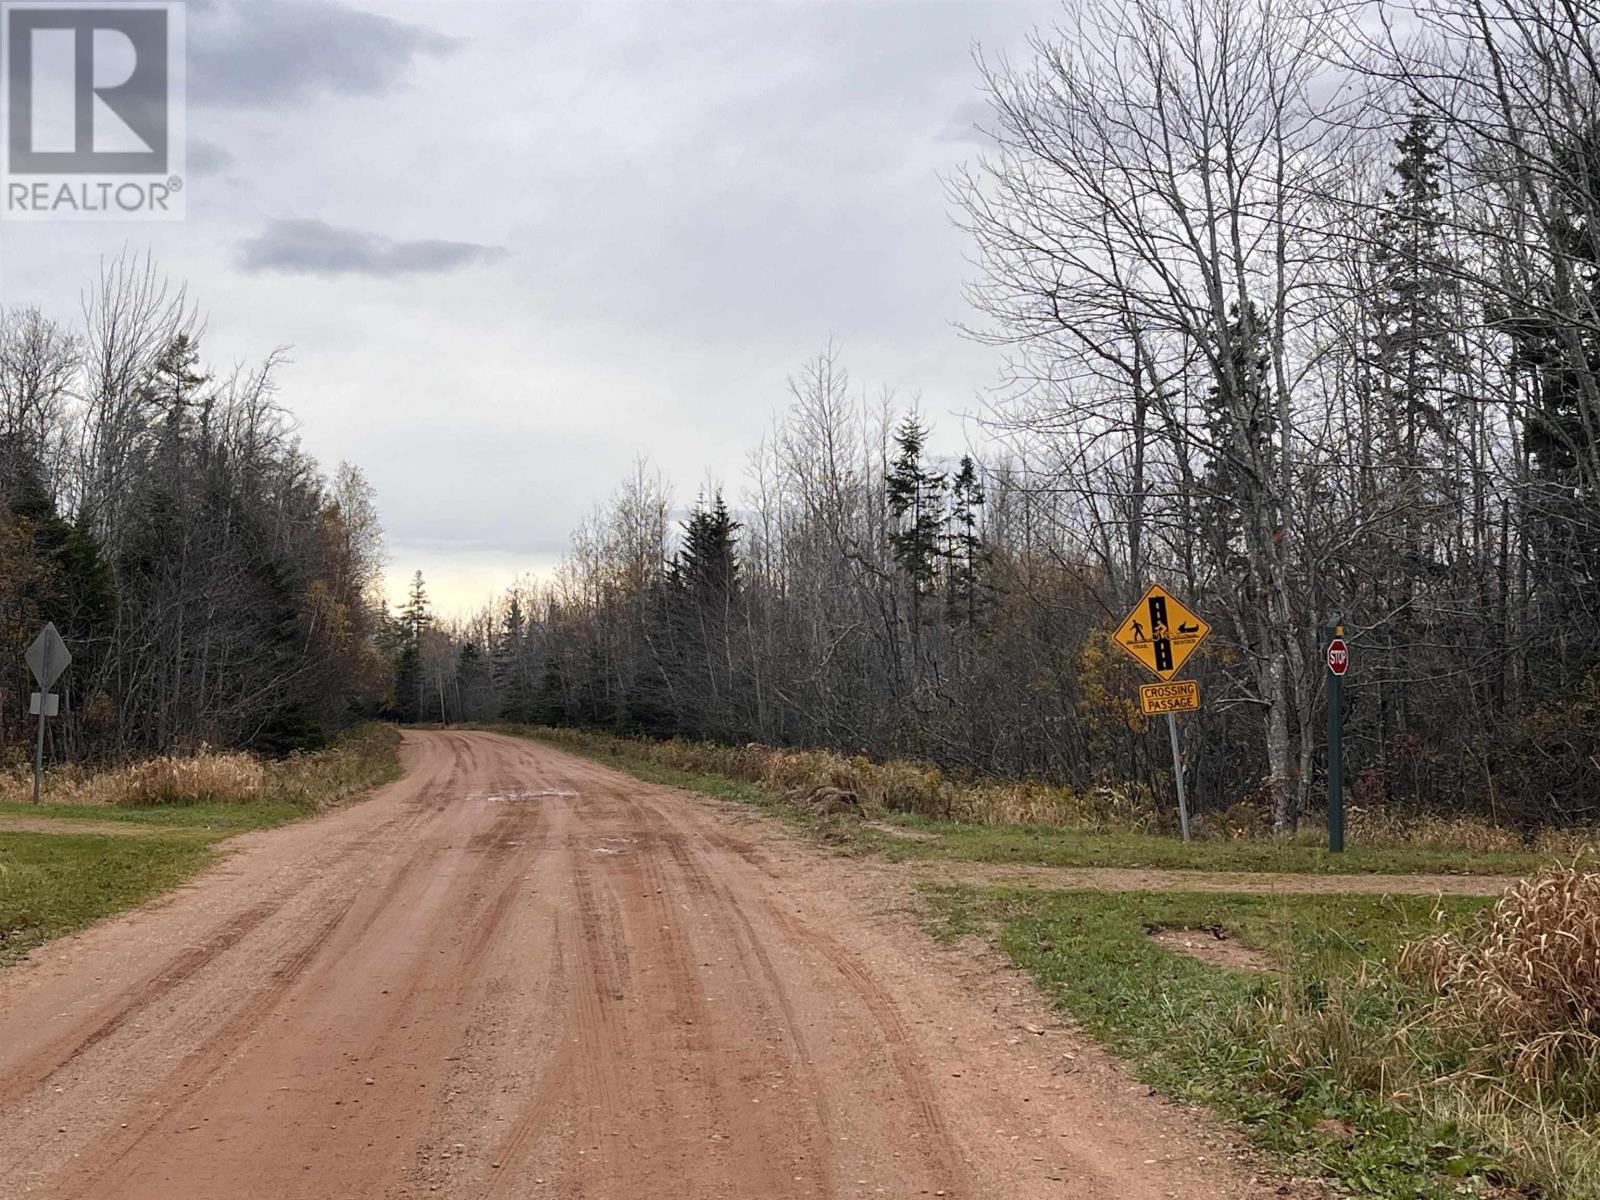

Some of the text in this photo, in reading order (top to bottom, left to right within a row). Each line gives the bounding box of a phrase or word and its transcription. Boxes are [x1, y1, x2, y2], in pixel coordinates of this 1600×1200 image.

[1330, 650, 1346, 665] STOP
[1144, 684, 1194, 699] CROSSING
[1148, 697, 1194, 711] PASSAGE
